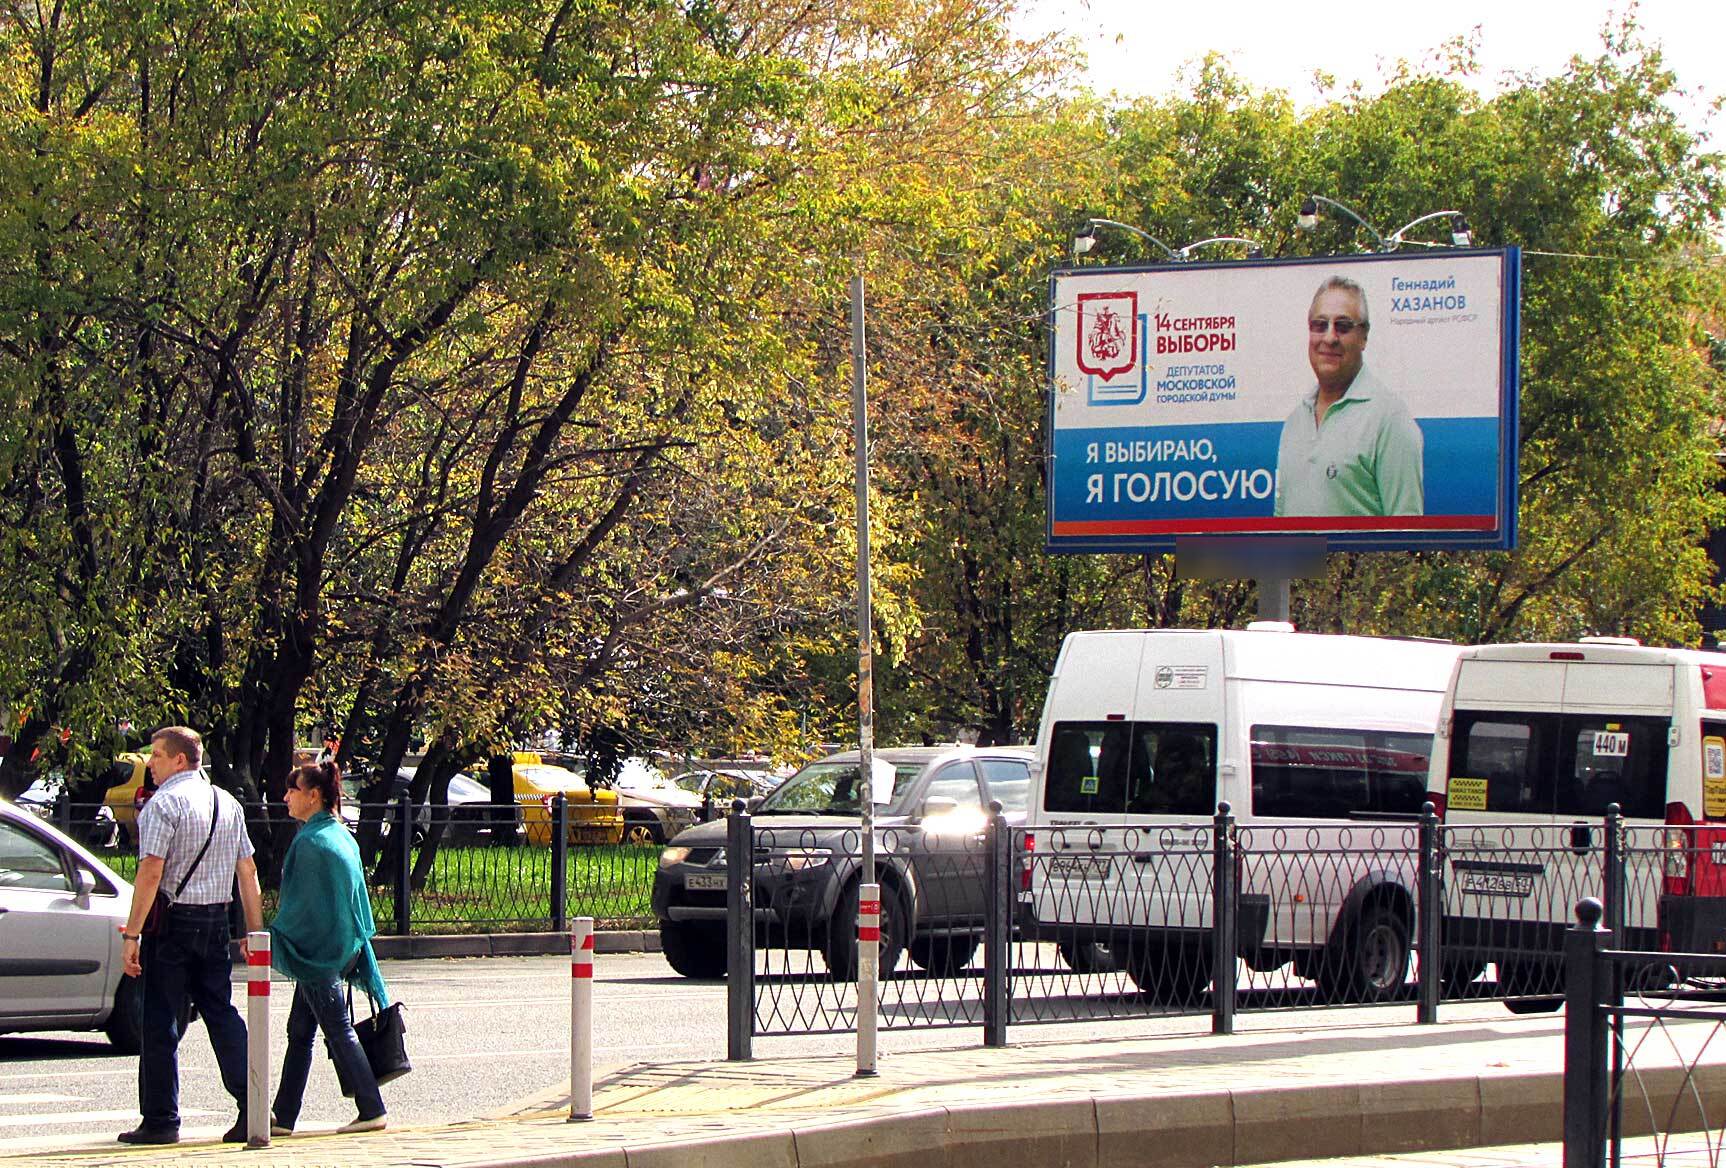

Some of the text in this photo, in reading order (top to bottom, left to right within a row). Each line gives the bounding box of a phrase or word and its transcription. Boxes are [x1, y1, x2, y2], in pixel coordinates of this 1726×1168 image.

[1391, 275, 1456, 291] Геннадий
[1390, 295, 1467, 312] ХАЗАНОВ
[1154, 313, 1236, 332] 14 СЕНТЯБРЯ
[1156, 333, 1236, 354] ВЫБОРЫ
[1166, 364, 1225, 377] ДЕПУТАТОВ
[1157, 375, 1236, 392] МОСКОВСКОЙ
[1157, 391, 1236, 404] ГОРОДСКОЙ ДУМЫ
[1086, 438, 1218, 464] Я ВЫБИРАЮ,
[1085, 473, 1104, 504] Я
[1595, 734, 1616, 753] 440
